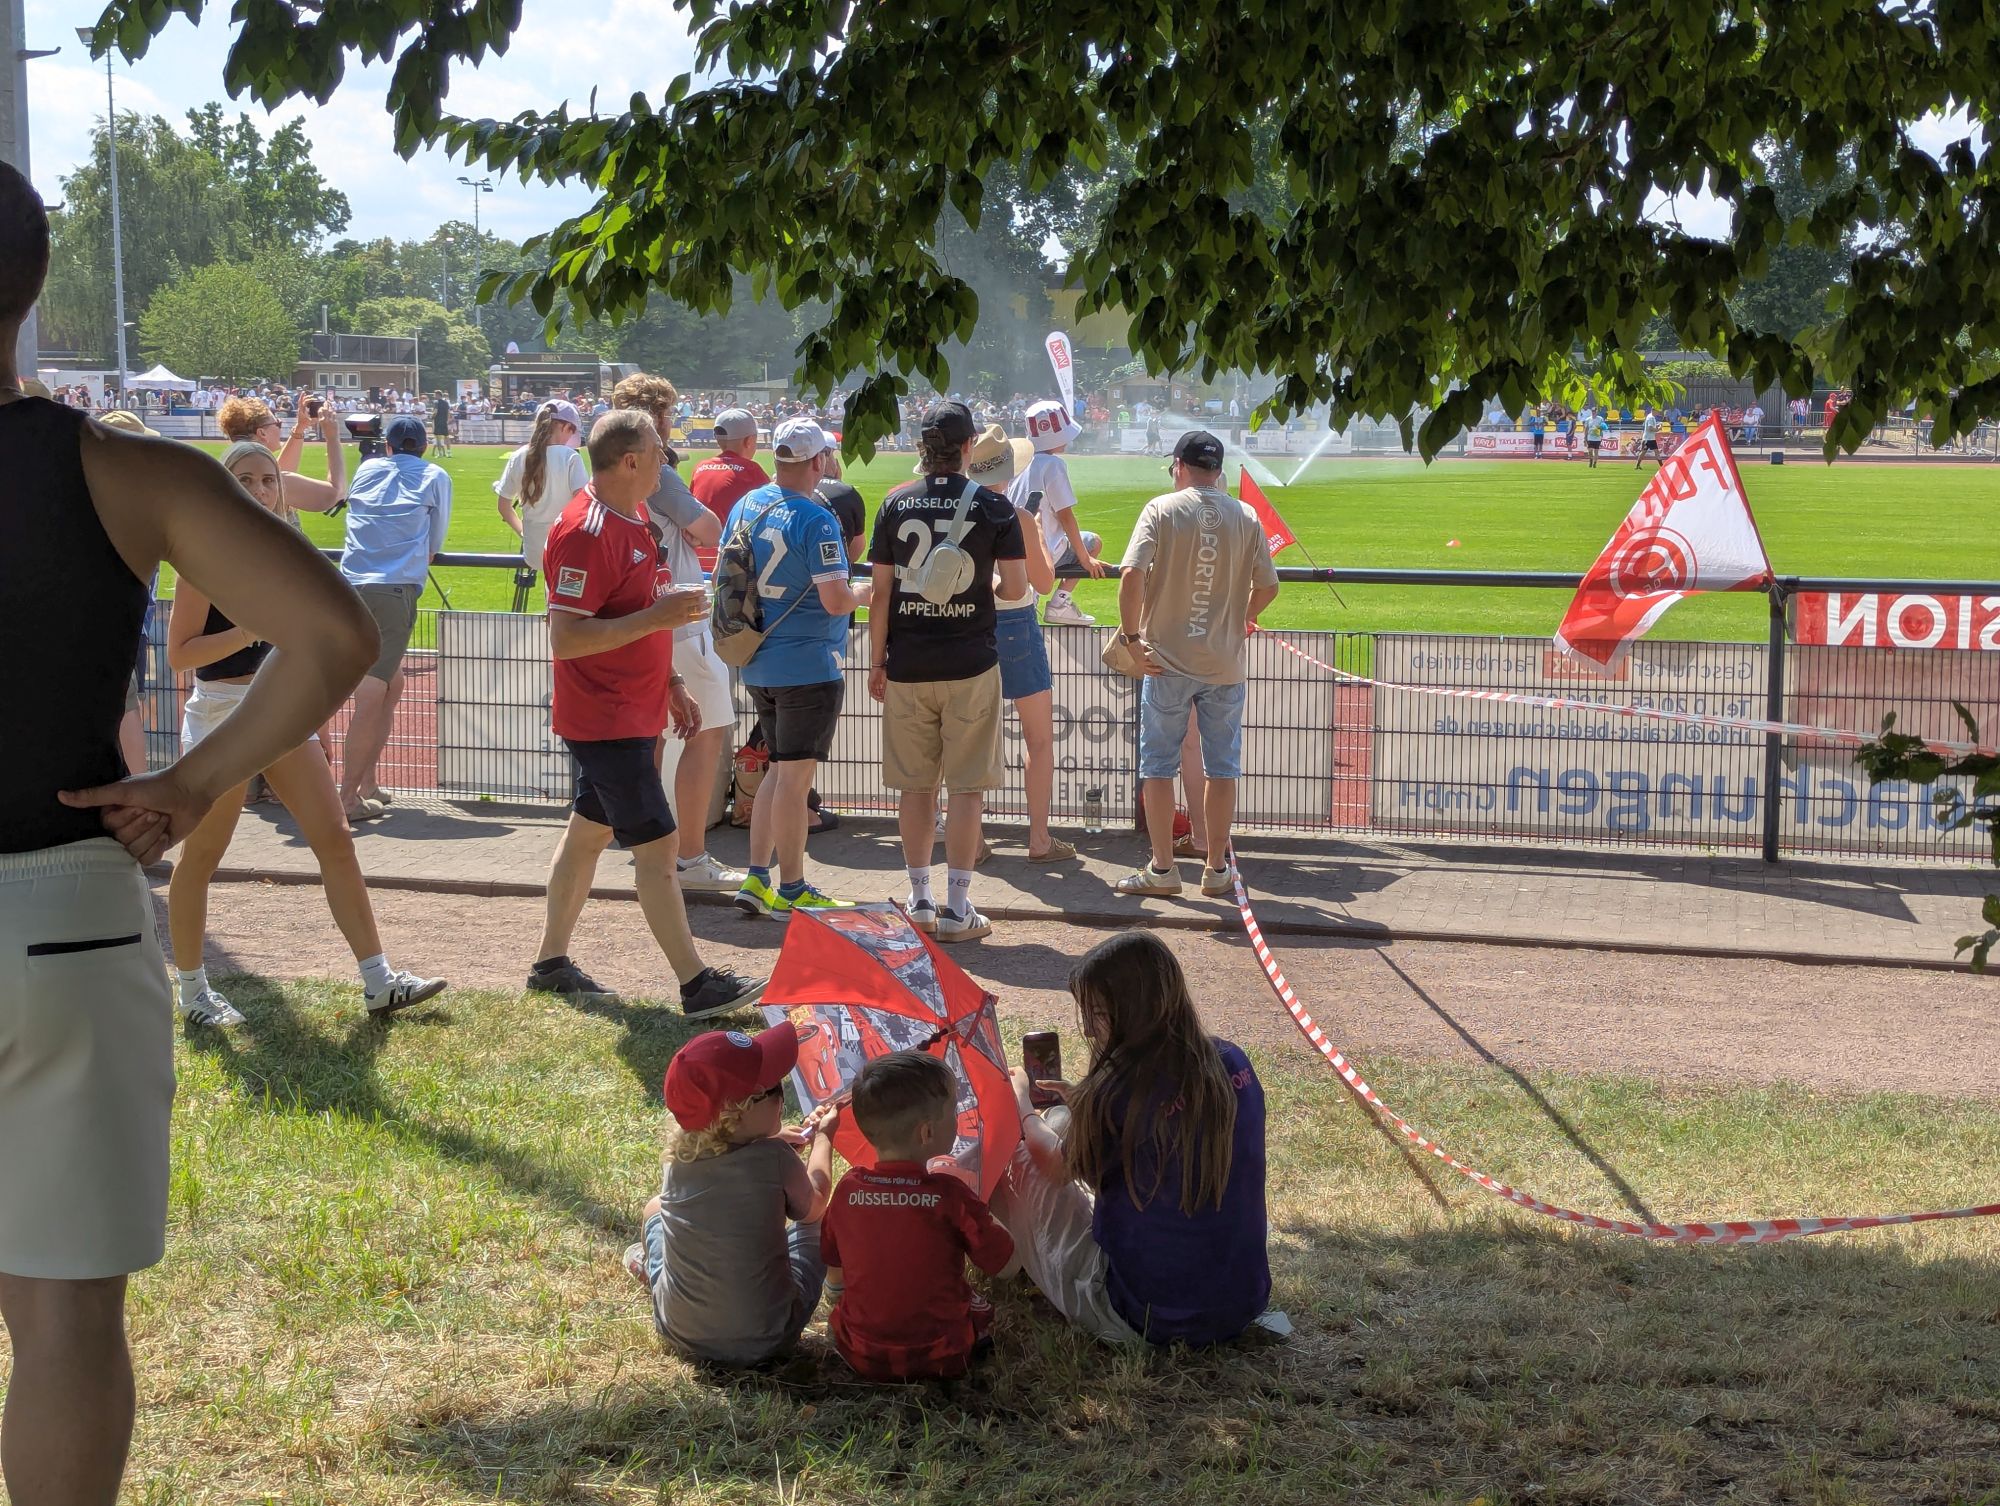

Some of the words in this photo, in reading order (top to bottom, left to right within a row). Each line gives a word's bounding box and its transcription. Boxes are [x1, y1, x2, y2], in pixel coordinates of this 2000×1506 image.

[897, 496, 980, 512] DÜSSELDOF
[1187, 531, 1219, 640] FORTUNA
[898, 600, 977, 618] APPELKAMP
[848, 1189, 942, 1208] DÜSSELDORF
